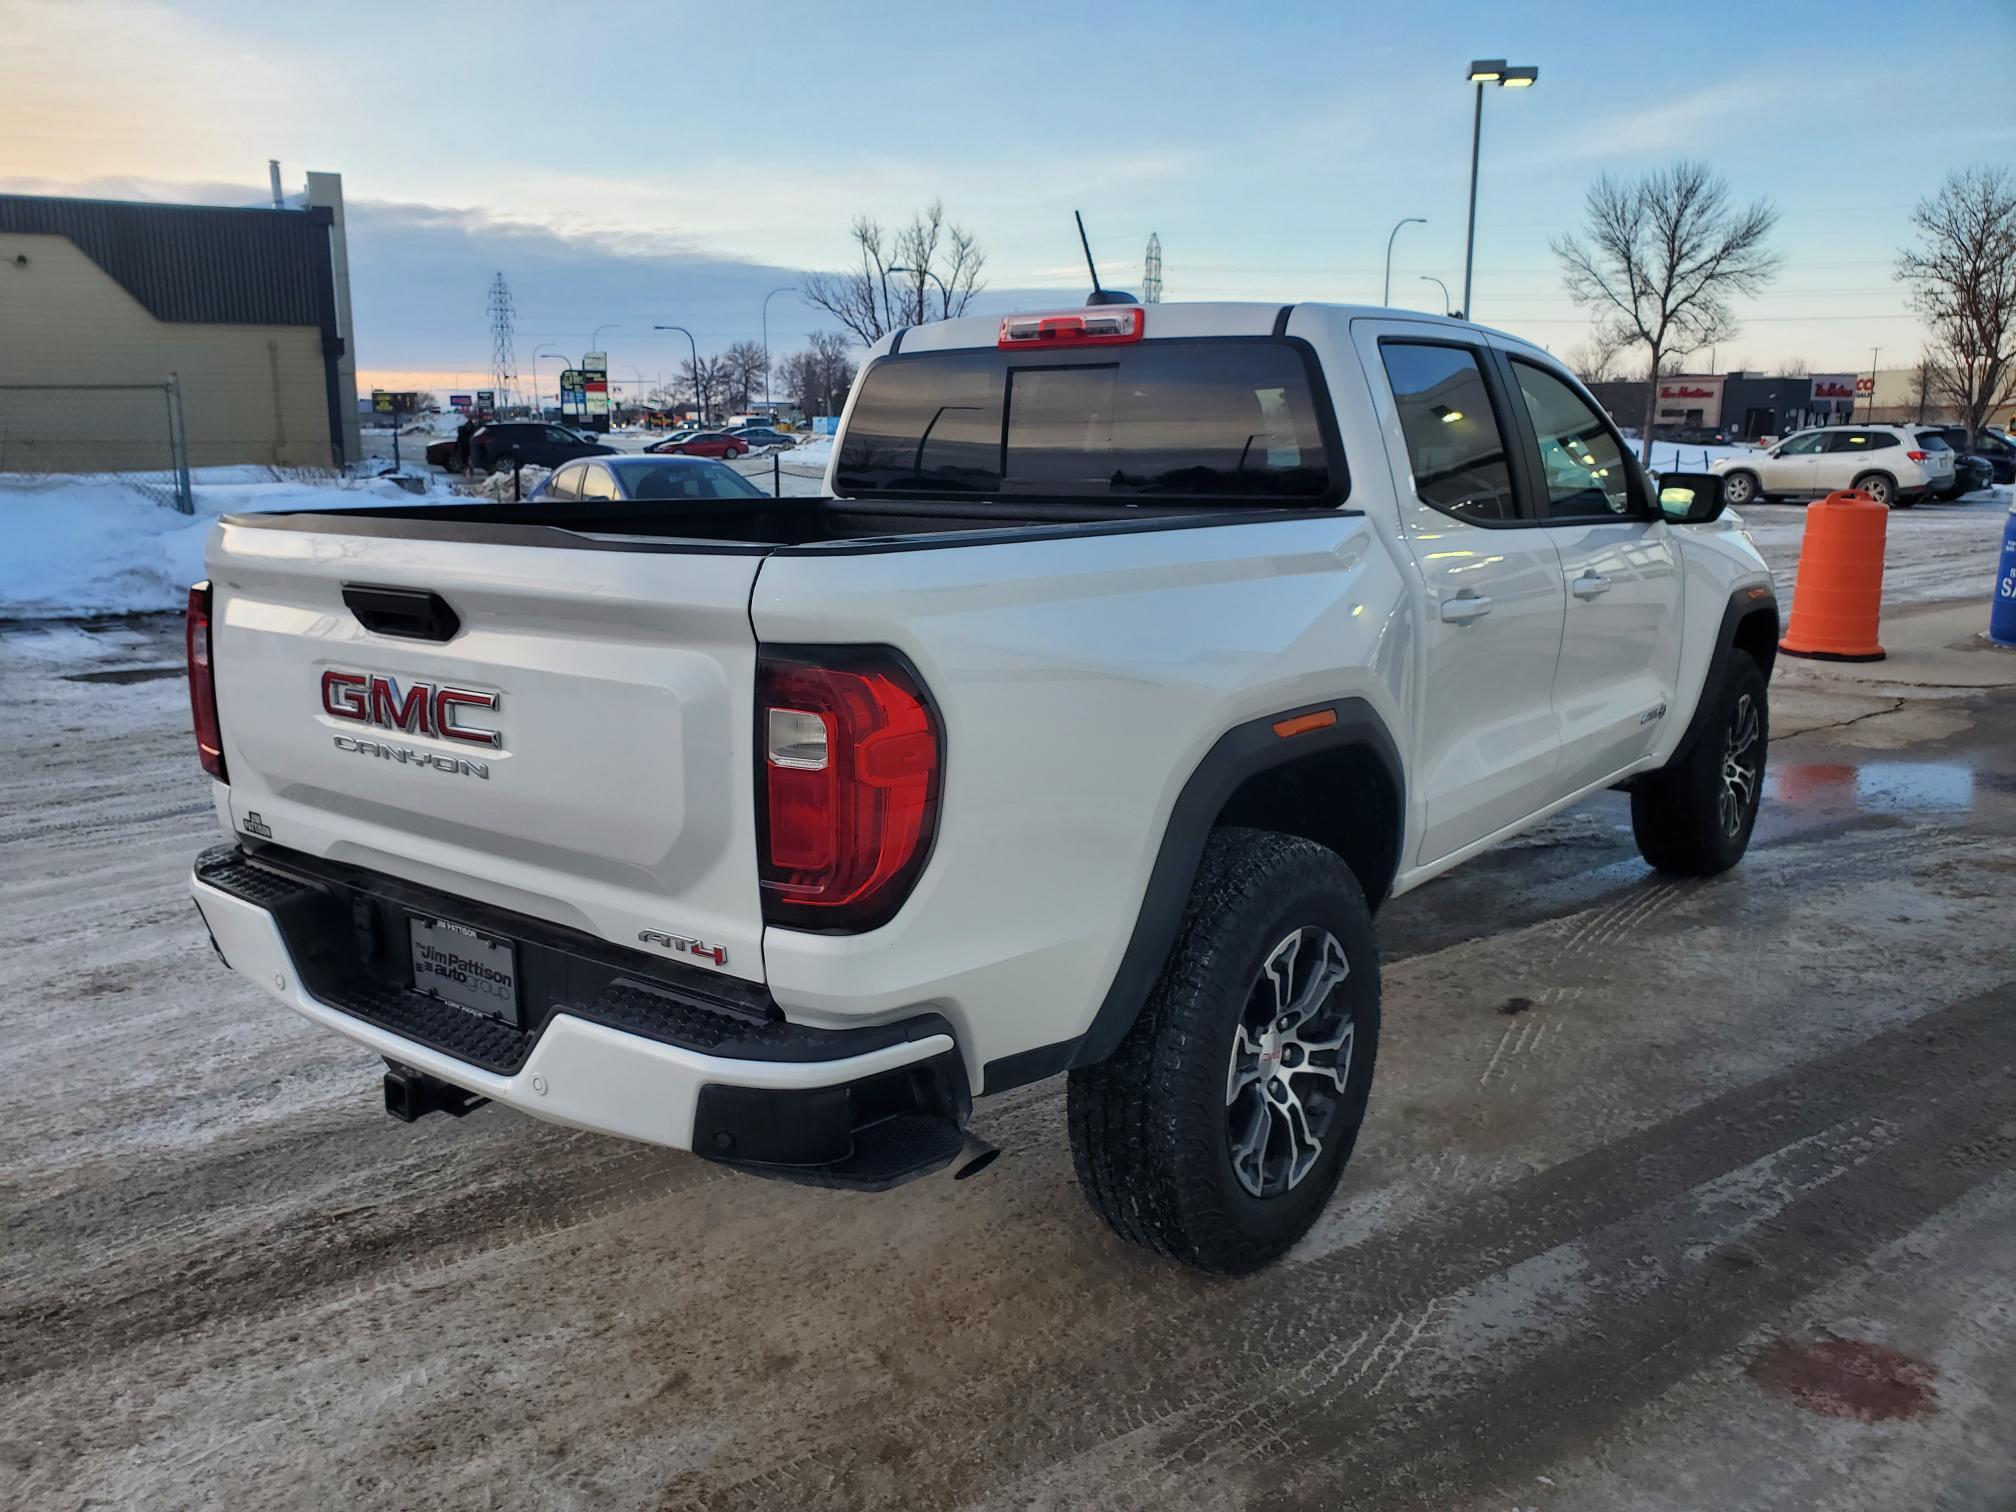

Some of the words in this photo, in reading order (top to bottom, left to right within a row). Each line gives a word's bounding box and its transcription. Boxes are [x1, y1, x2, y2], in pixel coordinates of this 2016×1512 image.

[321, 670, 502, 750] GMC
[333, 734, 490, 780] CANYON
[447, 922, 478, 938] PATTISON
[638, 927, 728, 967] AT4
